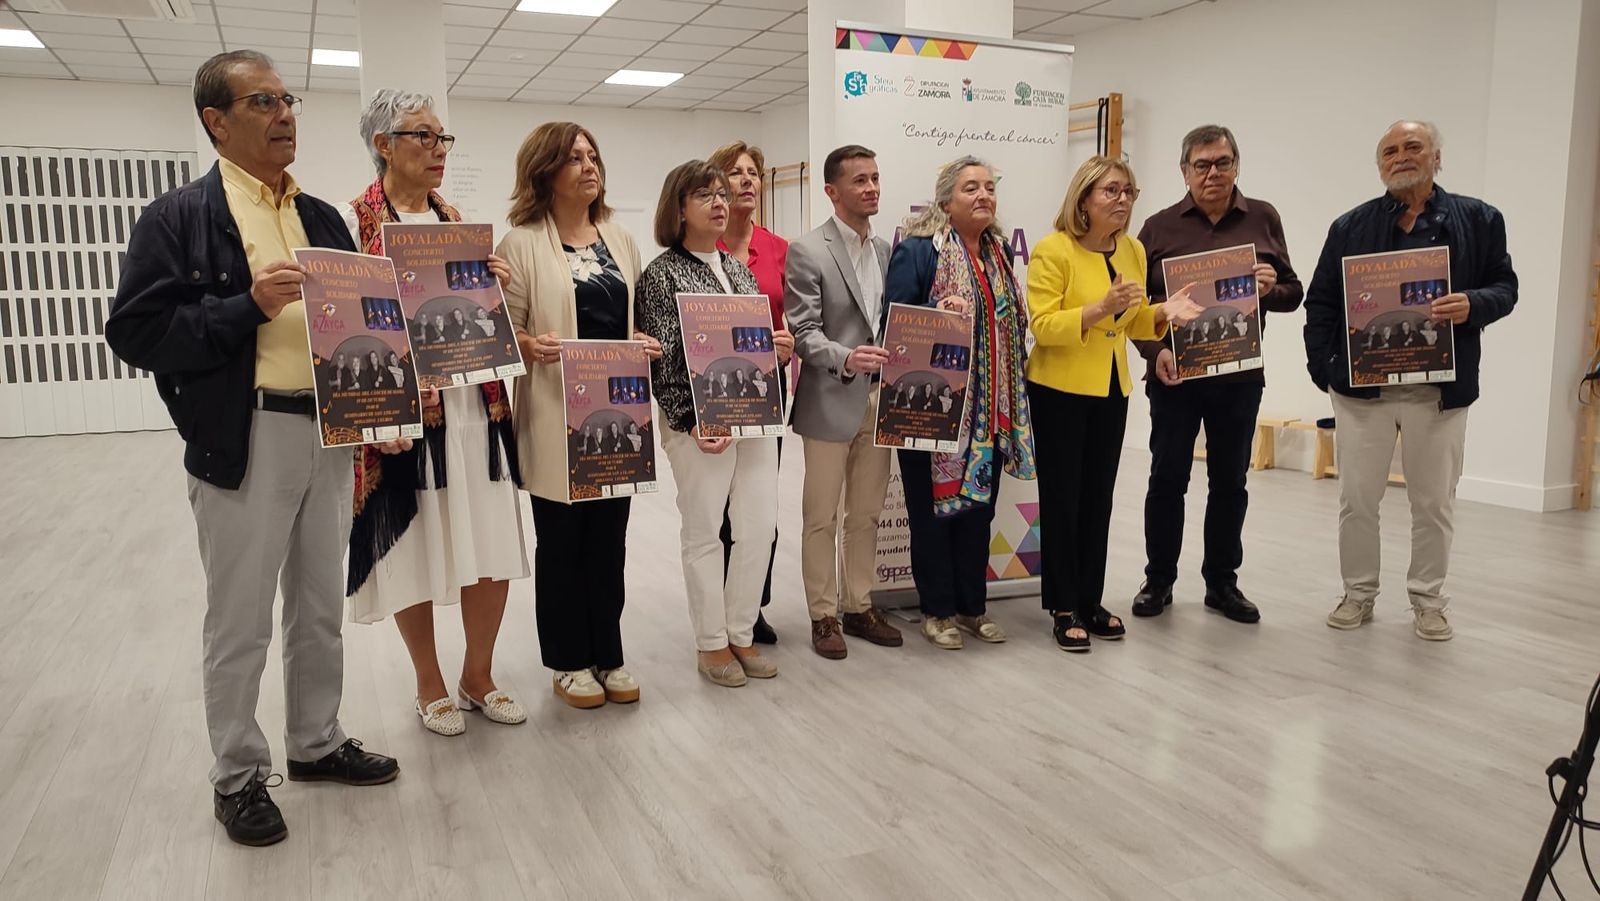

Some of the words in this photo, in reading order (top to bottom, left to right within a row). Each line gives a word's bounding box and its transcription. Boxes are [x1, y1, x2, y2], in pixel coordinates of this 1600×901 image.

[918, 89, 952, 99] ZAMORA
[981, 94, 1007, 102] ZAMORA
[954, 128, 997, 147] frente
[999, 130, 1014, 142] al
[389, 232, 462, 247] JOYALADA
[403, 248, 444, 256] CONCIERTO
[306, 260, 371, 278] JOYALADA
[1169, 259, 1228, 276] JOYALADA
[1349, 258, 1417, 275] JOYALADA
[321, 279, 358, 288] CONCIERTO
[684, 302, 744, 313] JOYALADA
[892, 313, 951, 330] JOYALADA
[566, 349, 621, 360] JOYALADA
[877, 519, 892, 529] 44
[877, 533, 910, 542] cazamor
[876, 545, 911, 556] ayudafr
